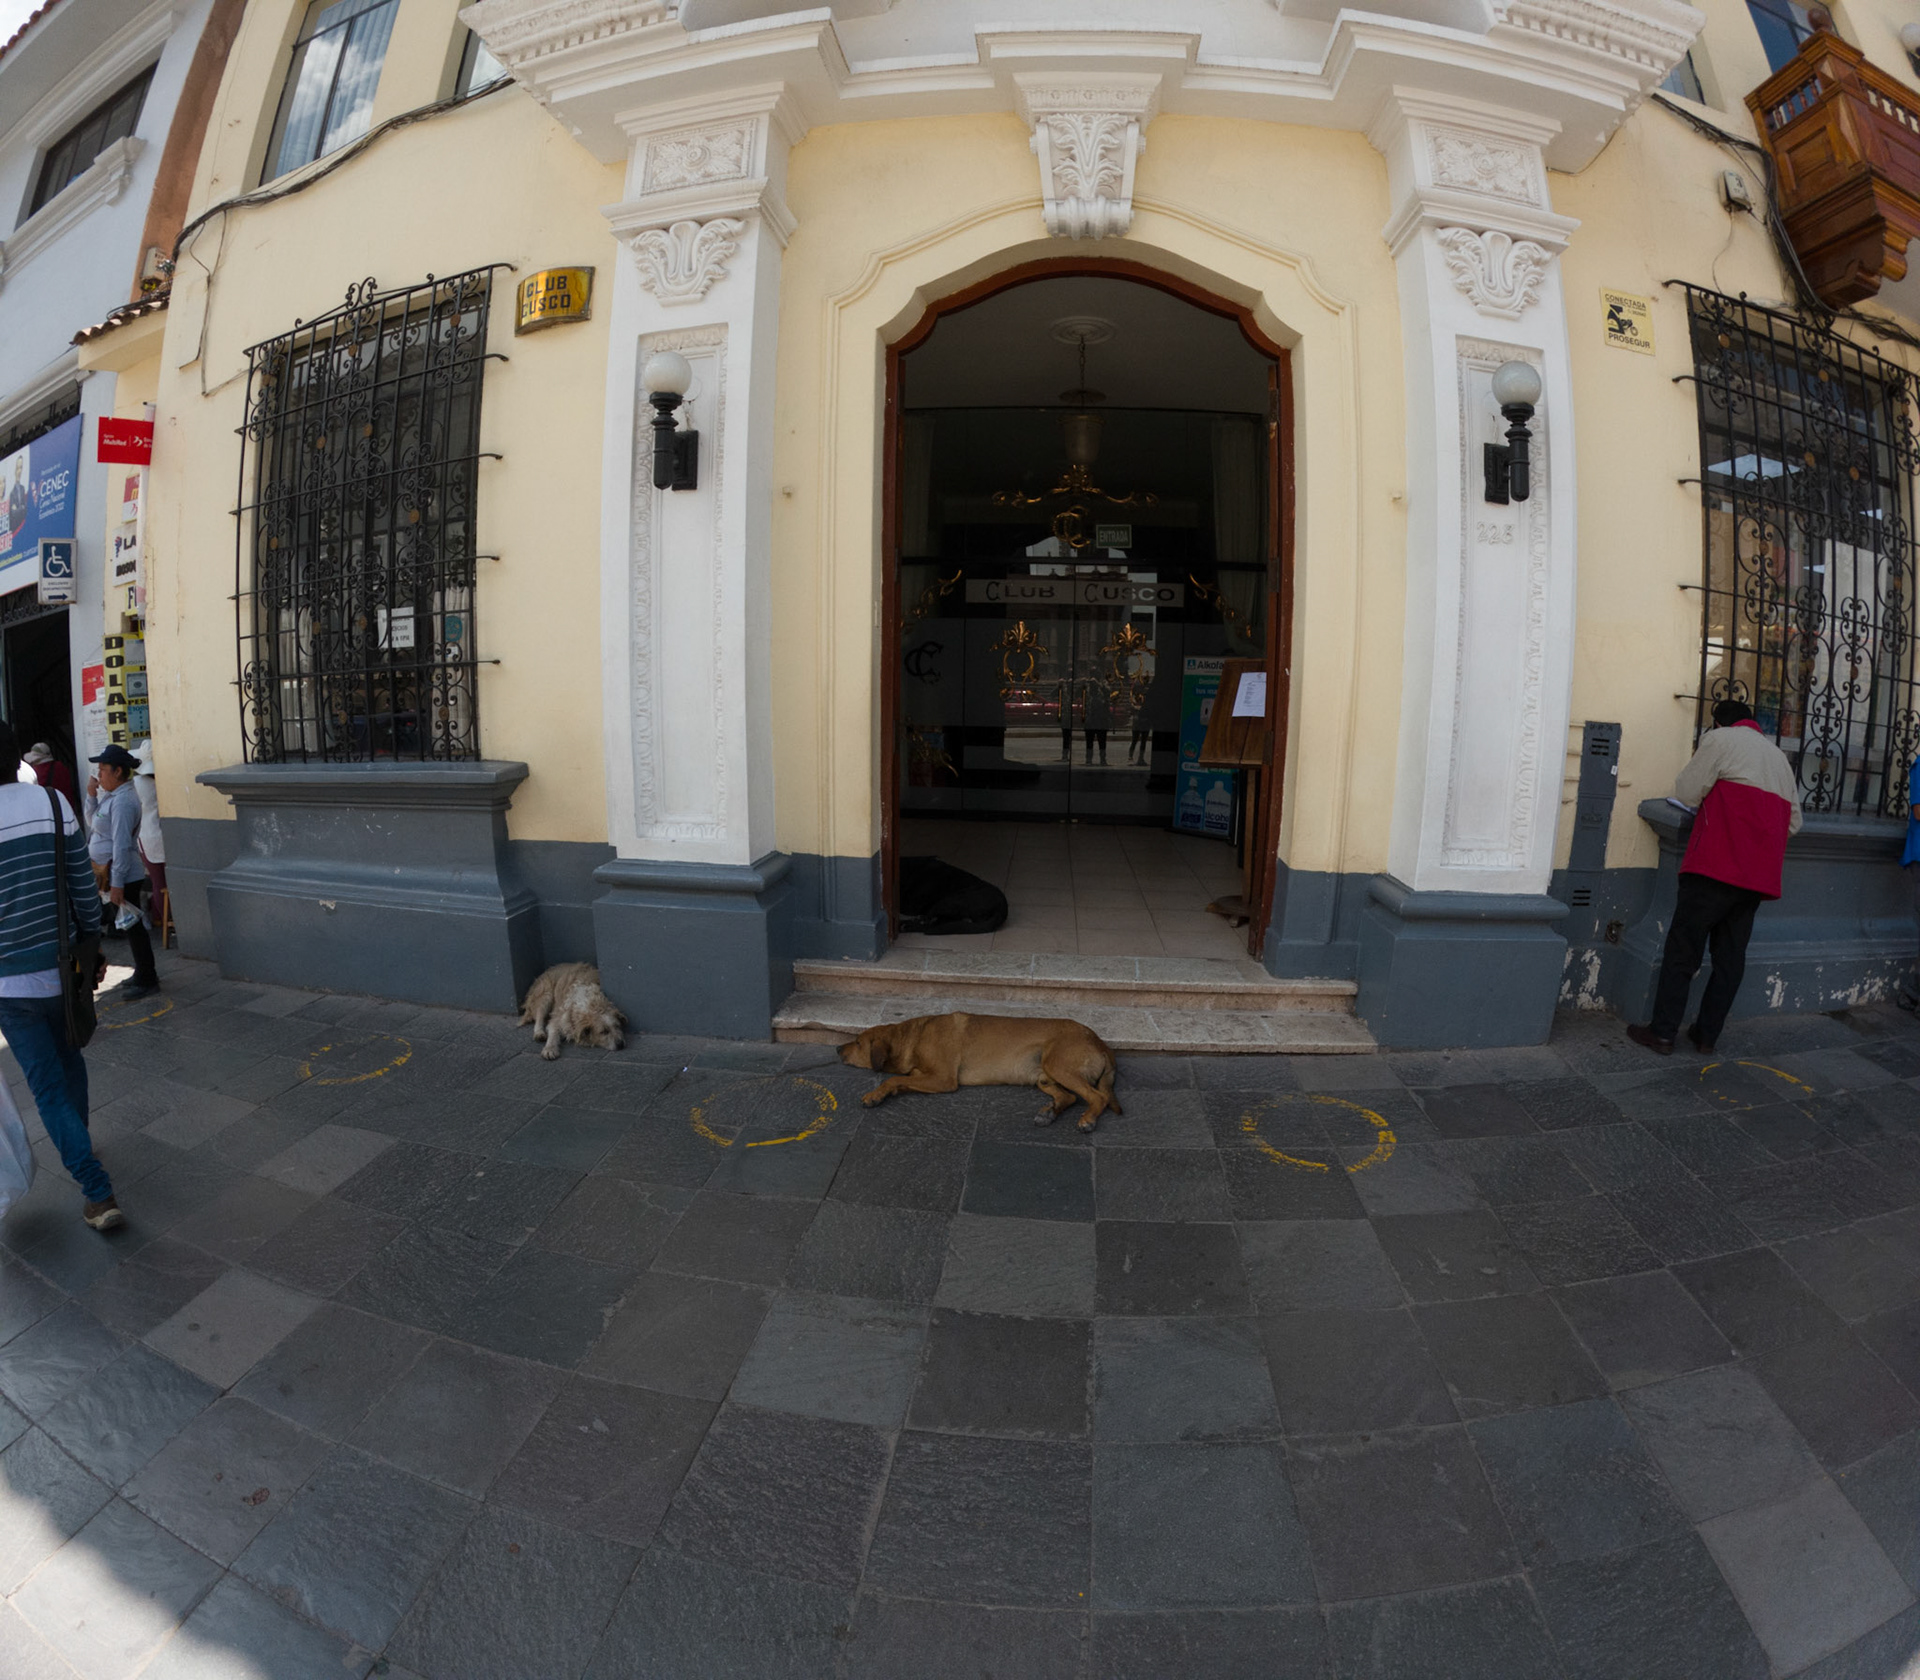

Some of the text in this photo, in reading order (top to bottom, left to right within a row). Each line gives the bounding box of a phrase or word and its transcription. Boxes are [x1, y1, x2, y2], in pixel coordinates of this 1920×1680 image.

[526, 275, 568, 299] CLUB
[521, 294, 571, 318] CUSCO
[1604, 293, 1646, 309] CONECTADA
[1608, 332, 1651, 349] PROSEGUR
[40, 469, 70, 499] CENEC
[1098, 529, 1130, 543] ENTRADA
[986, 580, 1175, 603] CLUB CUSCO
